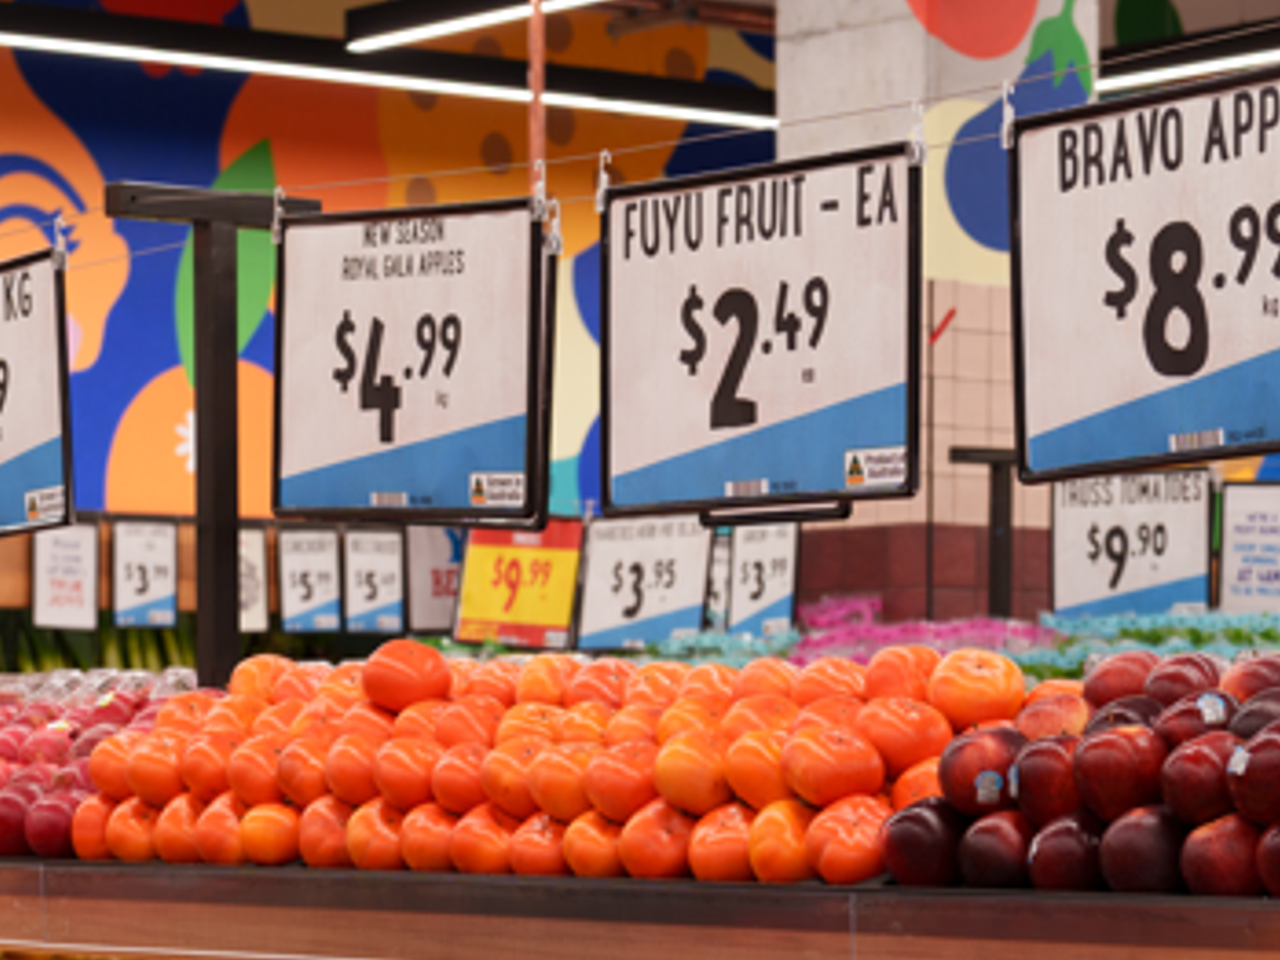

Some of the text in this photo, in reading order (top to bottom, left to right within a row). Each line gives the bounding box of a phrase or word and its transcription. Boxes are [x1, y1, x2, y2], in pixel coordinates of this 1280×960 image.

[1058, 106, 1184, 193] BRAVO
[363, 218, 446, 248] NEW SEASON
[624, 191, 705, 261] FUYU
[716, 174, 807, 249] FRUIT
[856, 162, 899, 228] EA
[383, 253, 414, 278] GALA
[419, 249, 466, 276] APPLES
[3, 272, 33, 322] KG
[332, 309, 462, 444] $4.99
[678, 276, 831, 432] $2.49
[491, 555, 553, 614] $9.99
[1087, 522, 1168, 590] $9.90
[611, 558, 676, 619] $3.95
